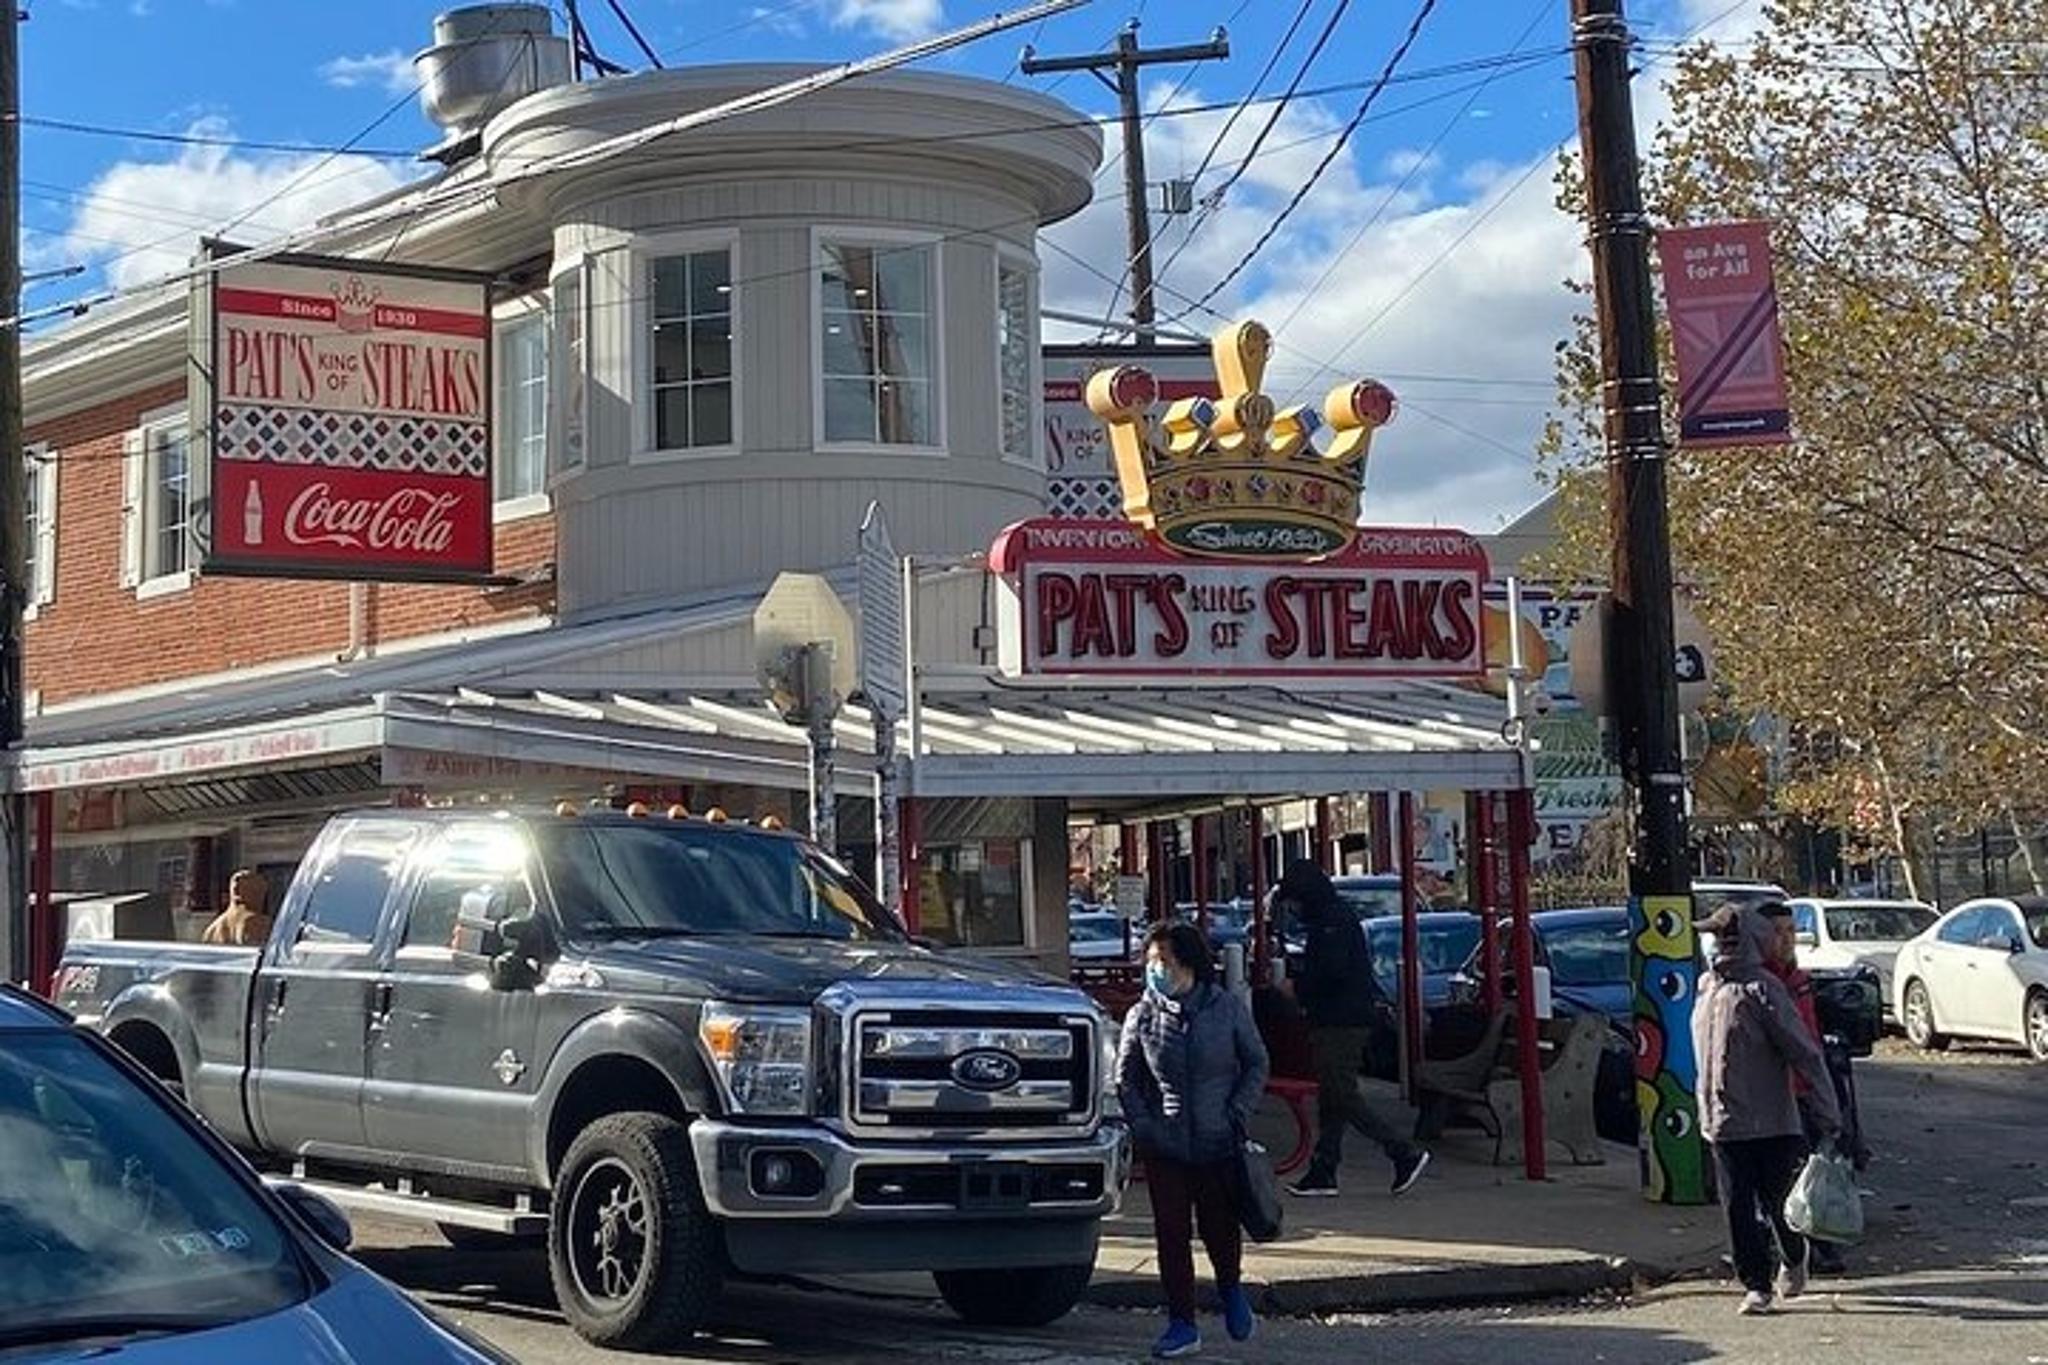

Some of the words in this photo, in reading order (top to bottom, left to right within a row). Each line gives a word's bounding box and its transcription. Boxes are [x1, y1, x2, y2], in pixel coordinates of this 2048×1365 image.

[1723, 258, 1750, 277] All
[281, 298, 332, 318] Since
[377, 308, 417, 326] 1930
[227, 326, 315, 403] PAT'S
[318, 353, 358, 373] KING
[326, 373, 350, 391] OF
[361, 339, 480, 418] STEAKS
[1066, 428, 1102, 442] KING
[283, 482, 464, 553] Coca-Cola
[1190, 584, 1257, 615] KING
[1037, 572, 1190, 659] PAT'S
[1263, 575, 1477, 661] STEAKS
[1211, 621, 1246, 650] OF
